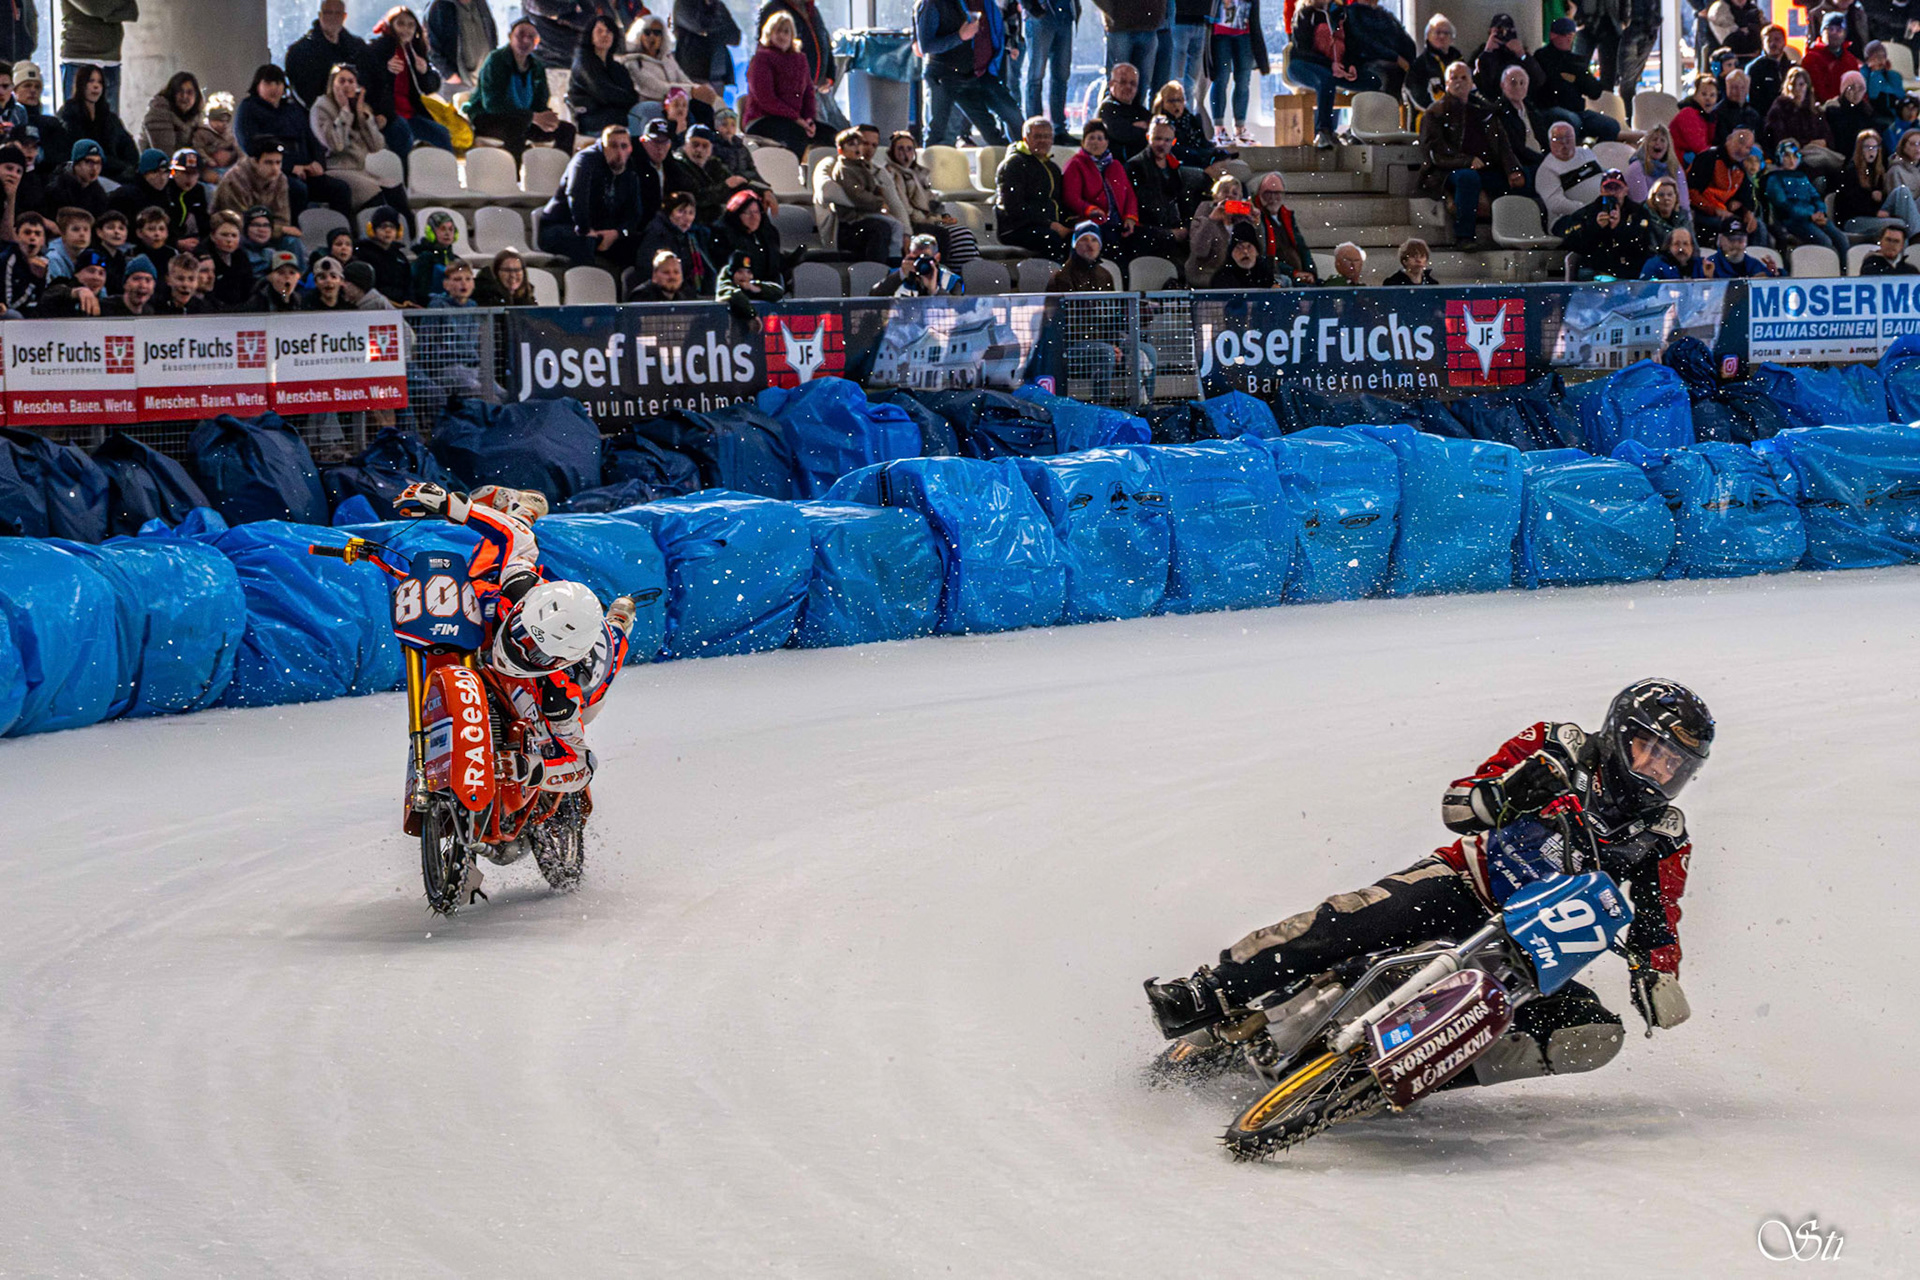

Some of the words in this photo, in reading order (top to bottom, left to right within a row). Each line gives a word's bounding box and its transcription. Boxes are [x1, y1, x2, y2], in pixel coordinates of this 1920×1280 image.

[1752, 285, 1877, 317] MOSER
[1754, 321, 1876, 339] BAUMASCHINEN
[12, 341, 54, 368] Josef
[58, 341, 101, 362] Fuchs
[144, 338, 185, 364] Josef
[189, 337, 233, 358] Fuchs
[275, 333, 317, 360] Josef
[321, 331, 366, 353] Fuchs
[798, 344, 814, 365] JF
[1201, 316, 1310, 378] Josef
[1318, 313, 1434, 363] Fuchs
[519, 332, 626, 402] Josef
[636, 331, 755, 385] Fuchs
[13, 398, 68, 413] Menschen.
[69, 398, 103, 413] Bauen.
[104, 398, 136, 412] Werte.
[144, 394, 199, 410] Menschen.
[201, 393, 235, 407] Bauen.
[236, 392, 268, 406] Werte.
[276, 388, 332, 404] Menschen.
[333, 387, 368, 400] Bauen.
[369, 385, 402, 399] Werte.
[429, 623, 460, 636] FIM
[1538, 899, 1608, 954] 97
[1529, 932, 1559, 969] FIM
[1389, 1000, 1490, 1081] NORDMALINGS
